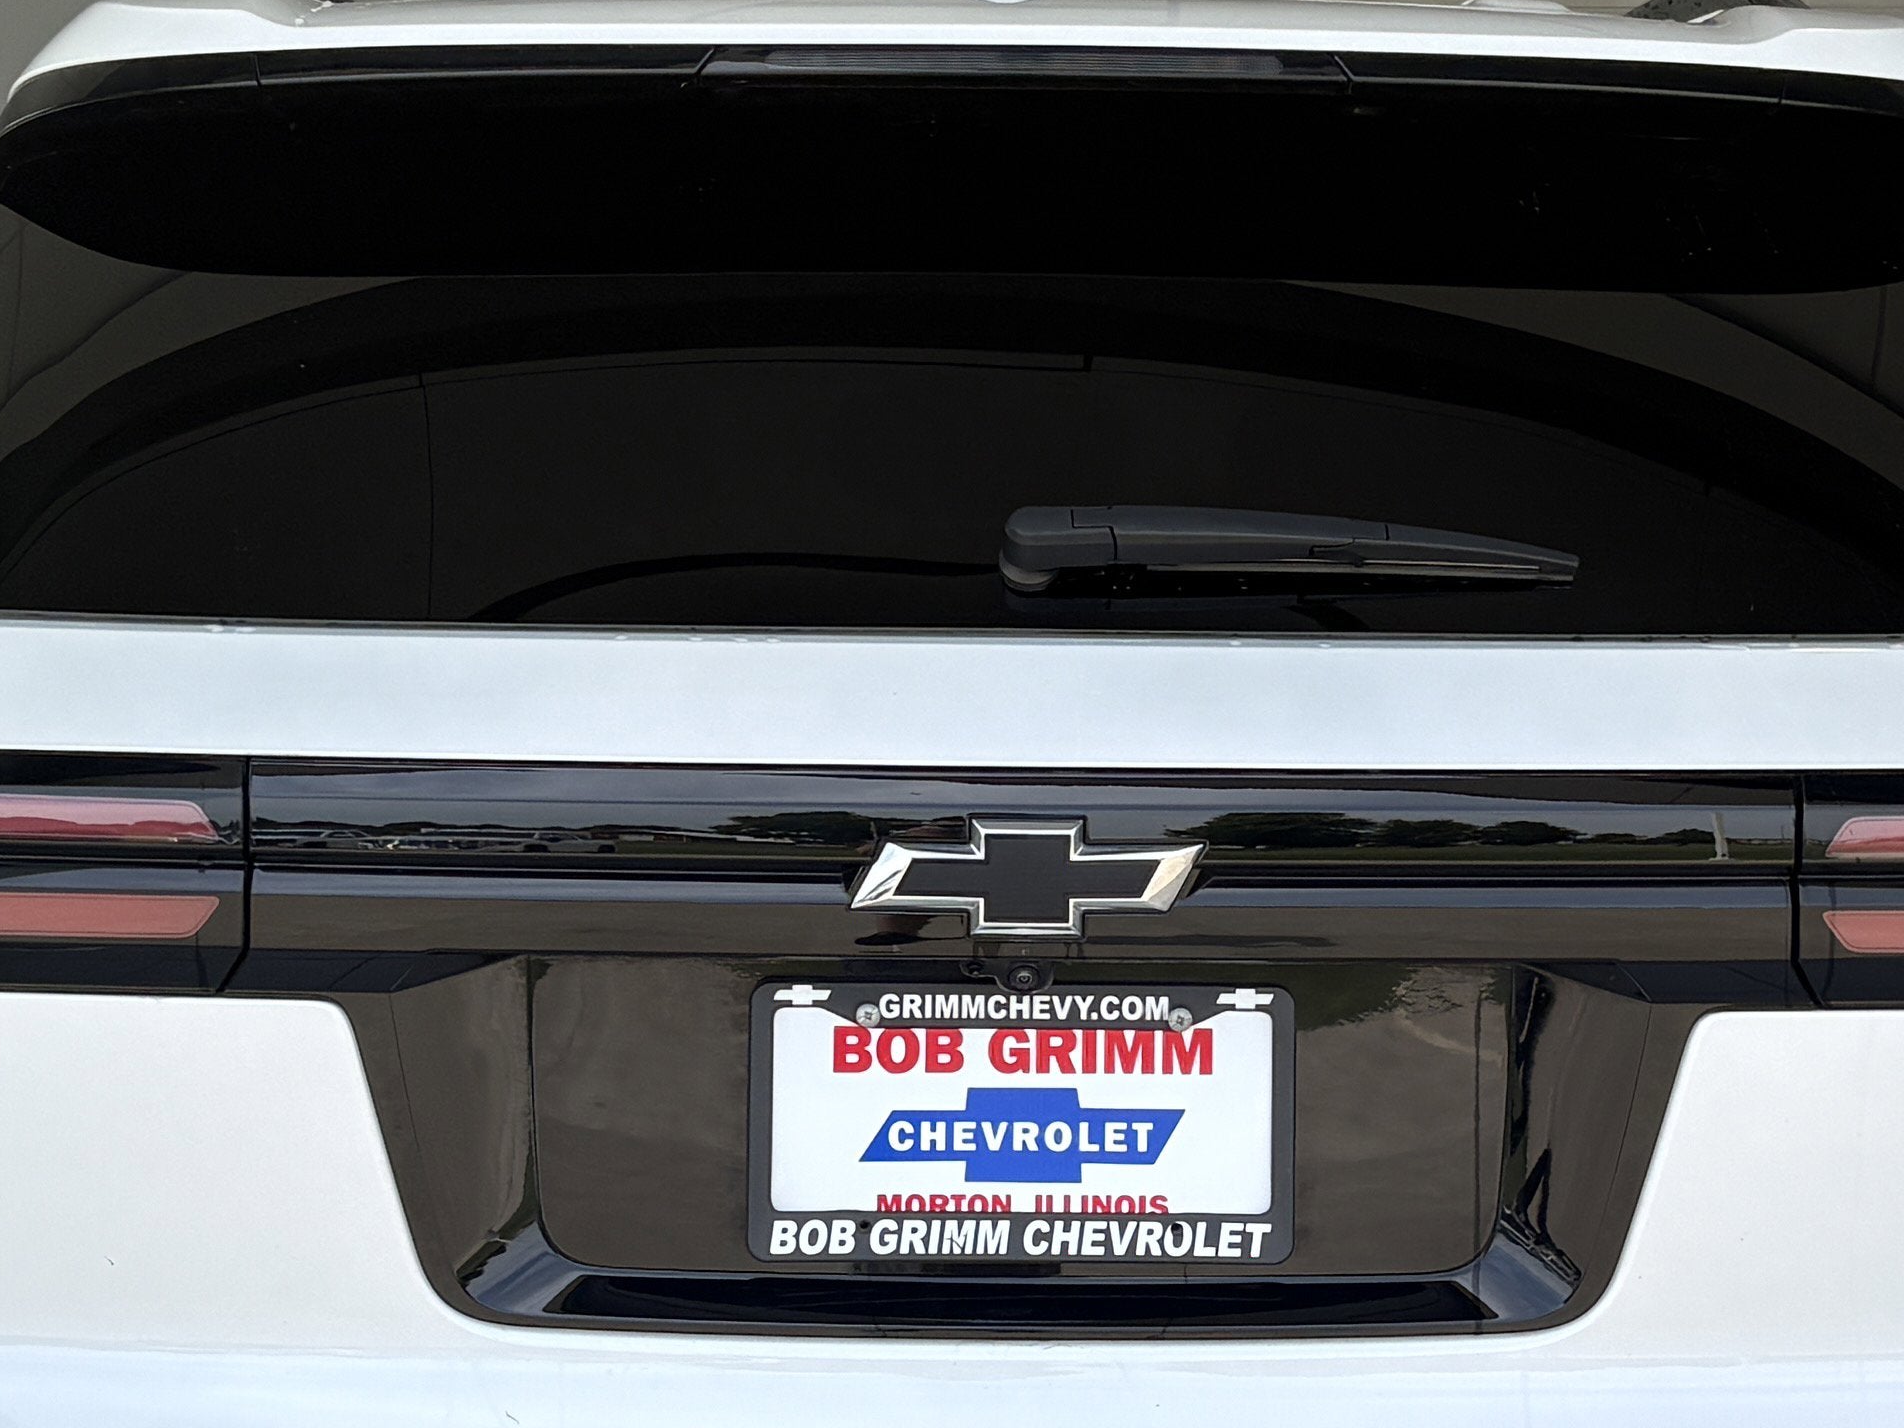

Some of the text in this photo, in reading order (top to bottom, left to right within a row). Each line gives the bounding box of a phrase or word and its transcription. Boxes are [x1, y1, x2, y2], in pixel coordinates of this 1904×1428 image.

[879, 992, 1170, 1022] GRIMMCHEVY.COM
[832, 1026, 1214, 1075] BOB GRIMM
[887, 1120, 1156, 1154] CHEVROLET
[769, 1219, 1273, 1259] BOB GRIMM CHEVROLET
